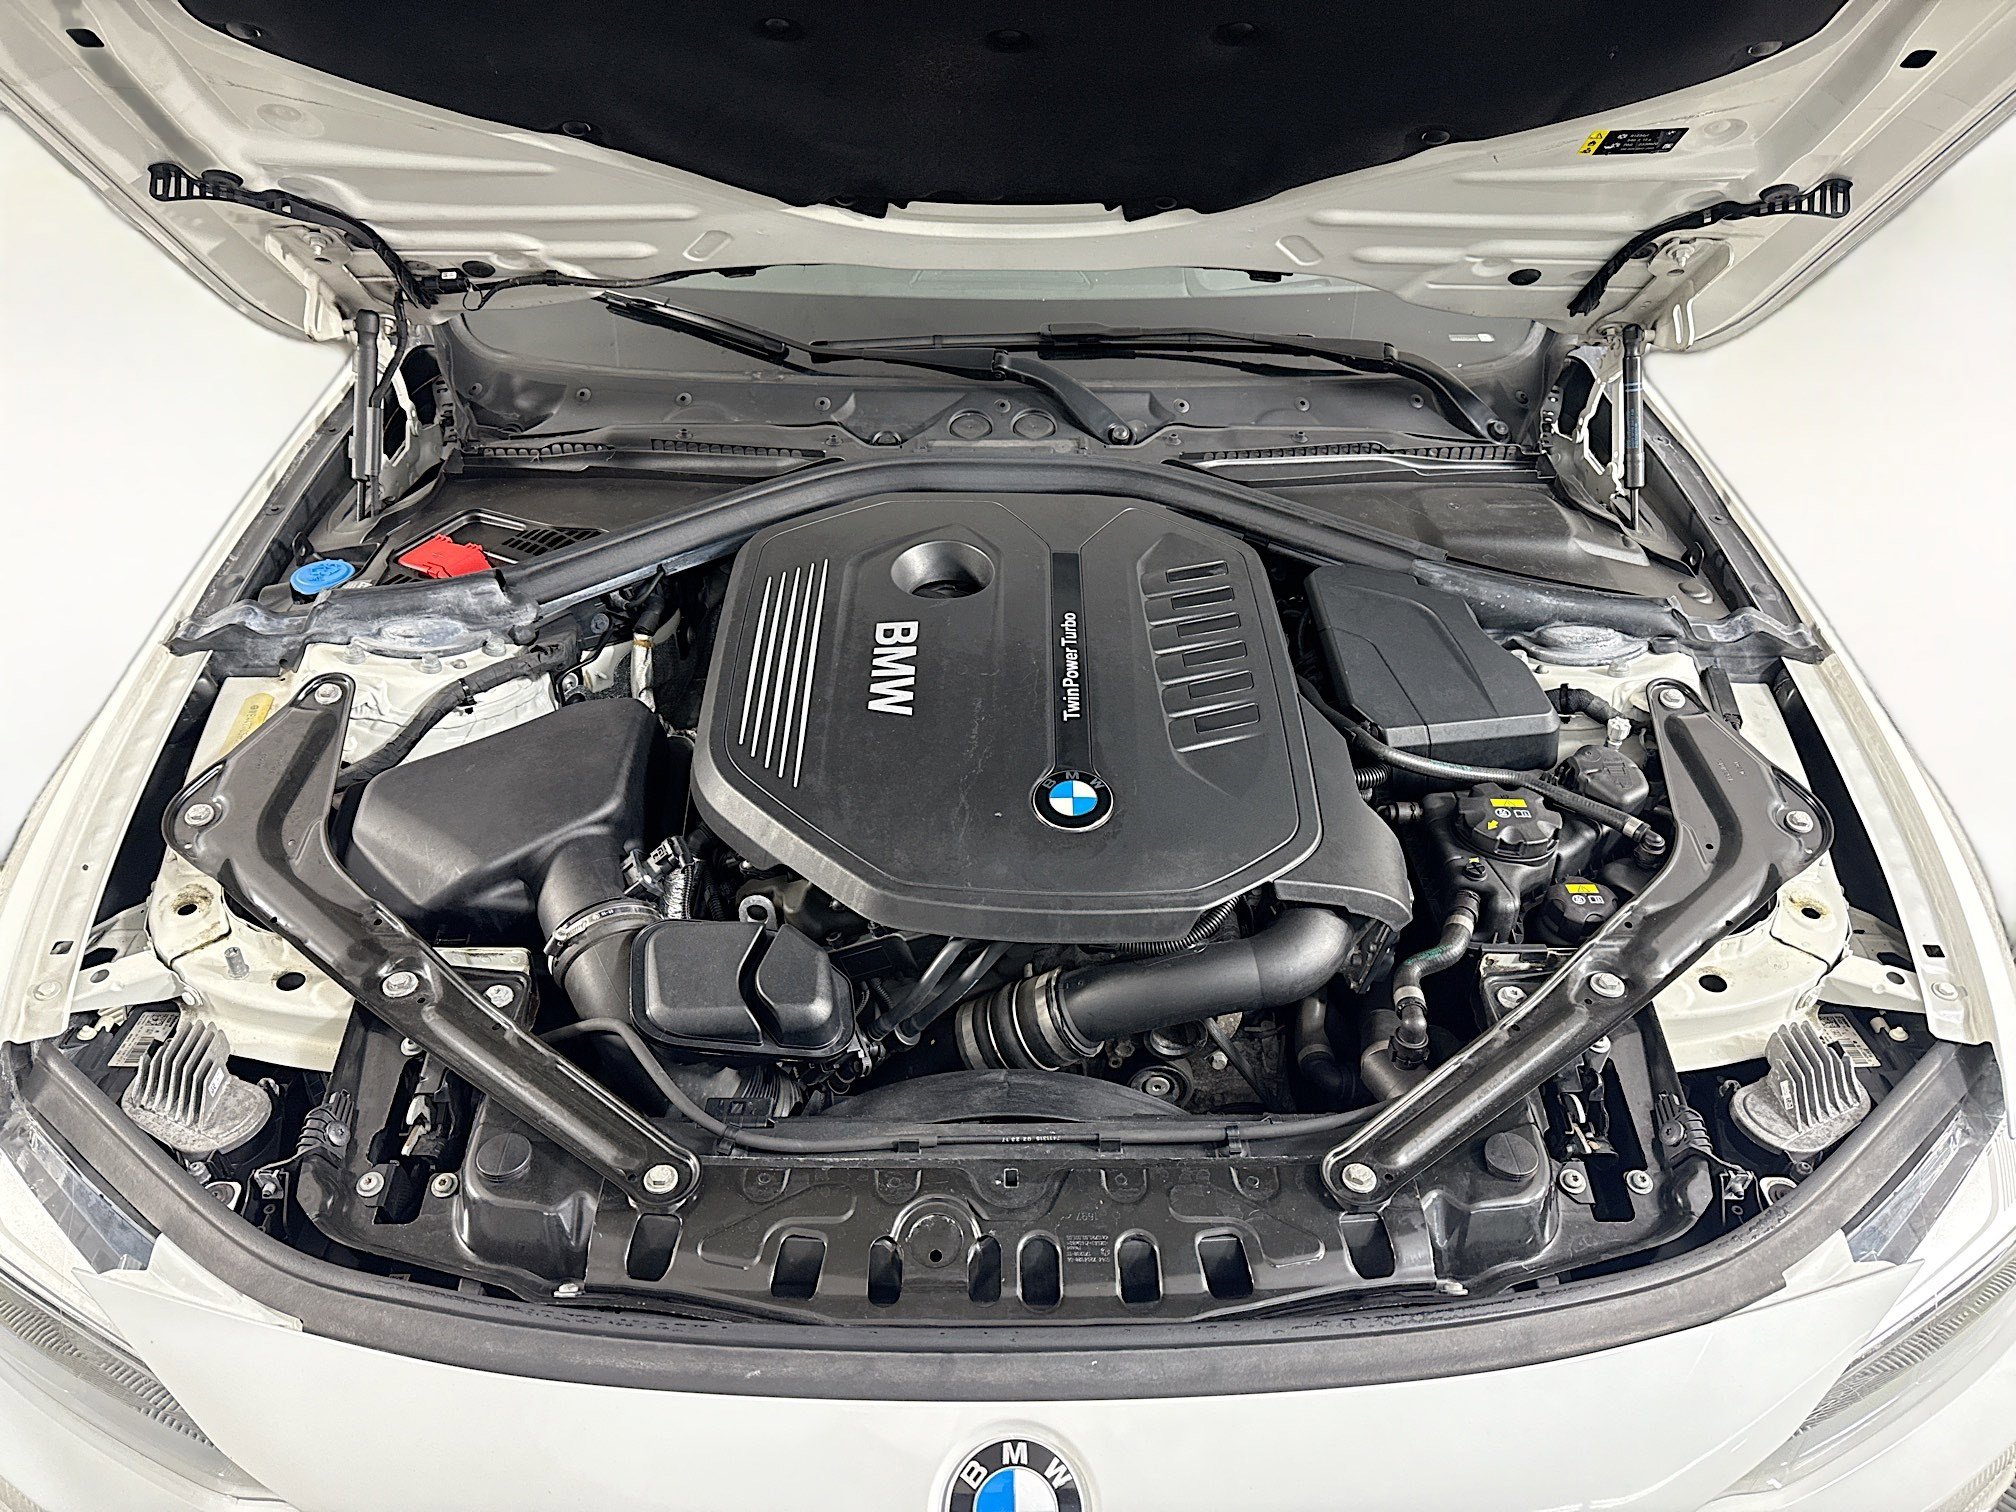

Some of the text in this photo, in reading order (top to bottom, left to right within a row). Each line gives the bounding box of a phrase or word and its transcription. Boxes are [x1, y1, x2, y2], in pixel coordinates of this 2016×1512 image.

[1061, 612, 1077, 646] Turbo
[867, 620, 919, 716] BMW
[1044, 770, 1104, 790] BMW
[959, 1441, 1073, 1490] BMW
